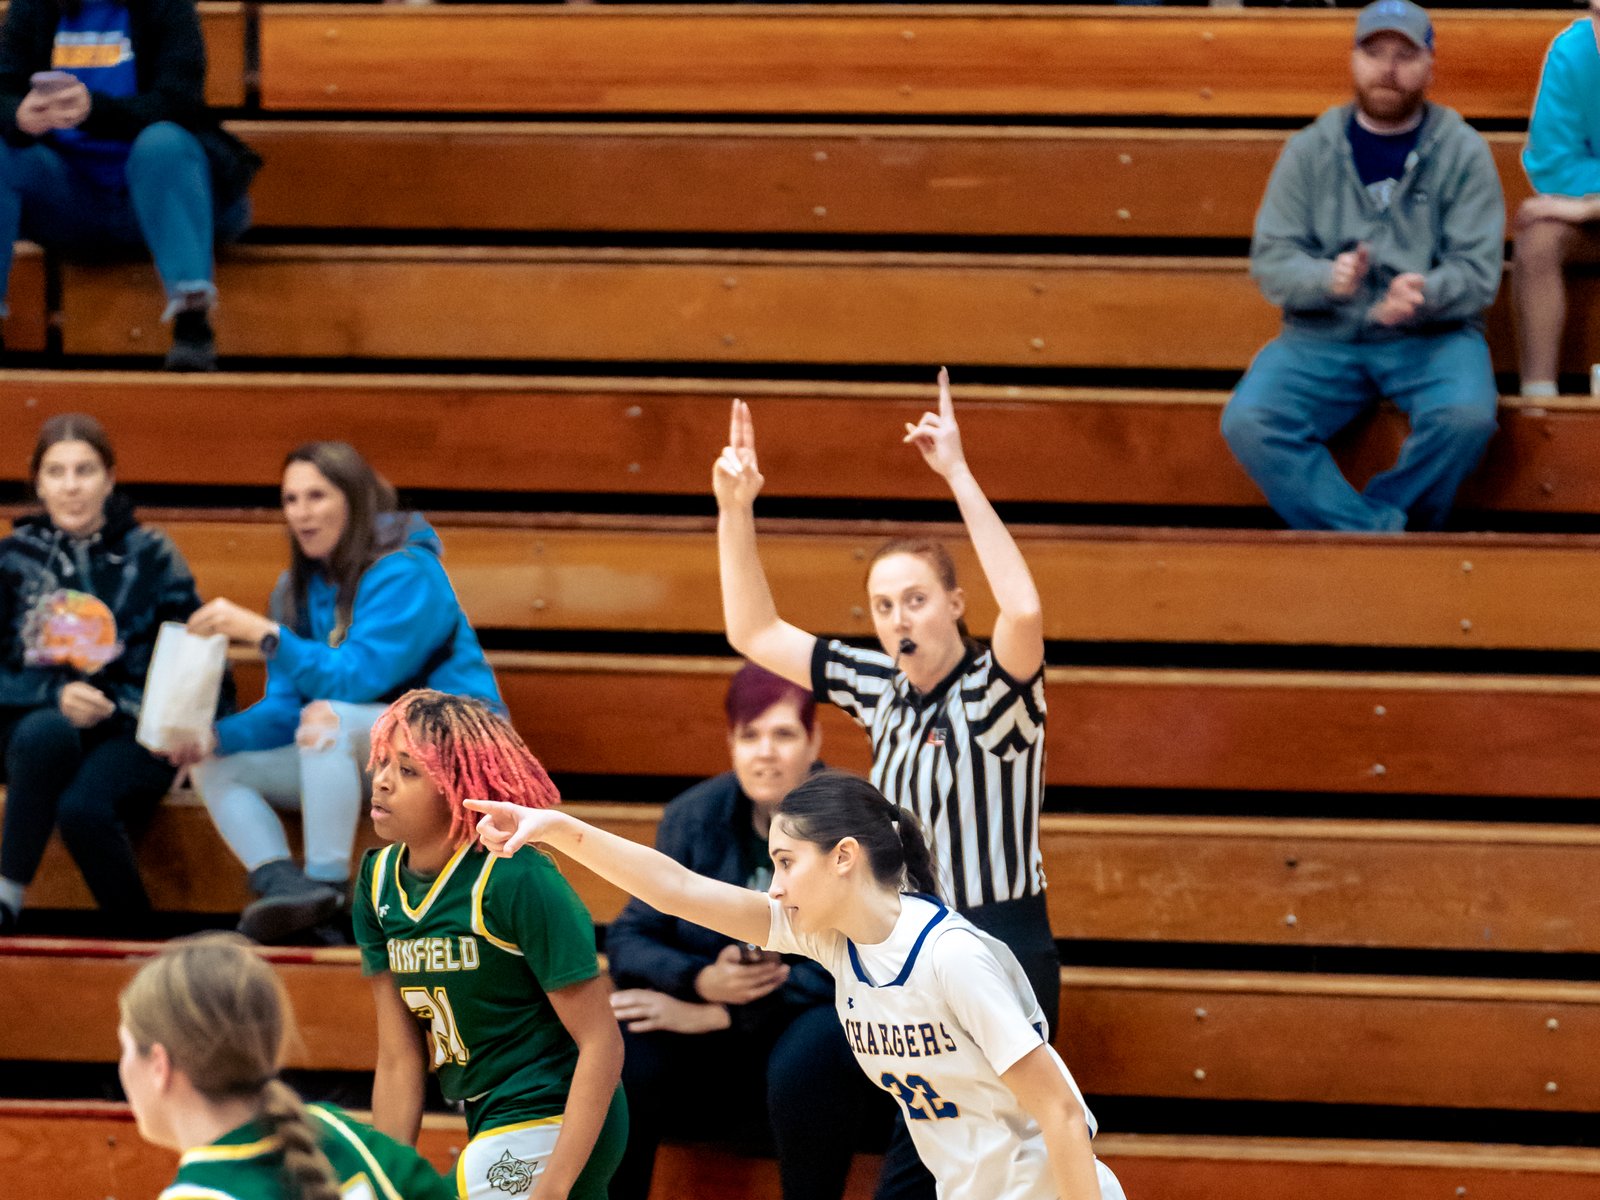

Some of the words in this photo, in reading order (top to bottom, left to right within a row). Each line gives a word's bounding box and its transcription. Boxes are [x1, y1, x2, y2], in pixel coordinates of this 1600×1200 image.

[387, 936, 480, 973] AINFIELD
[845, 1018, 957, 1057] CHARGERS
[880, 1072, 961, 1120] 22
